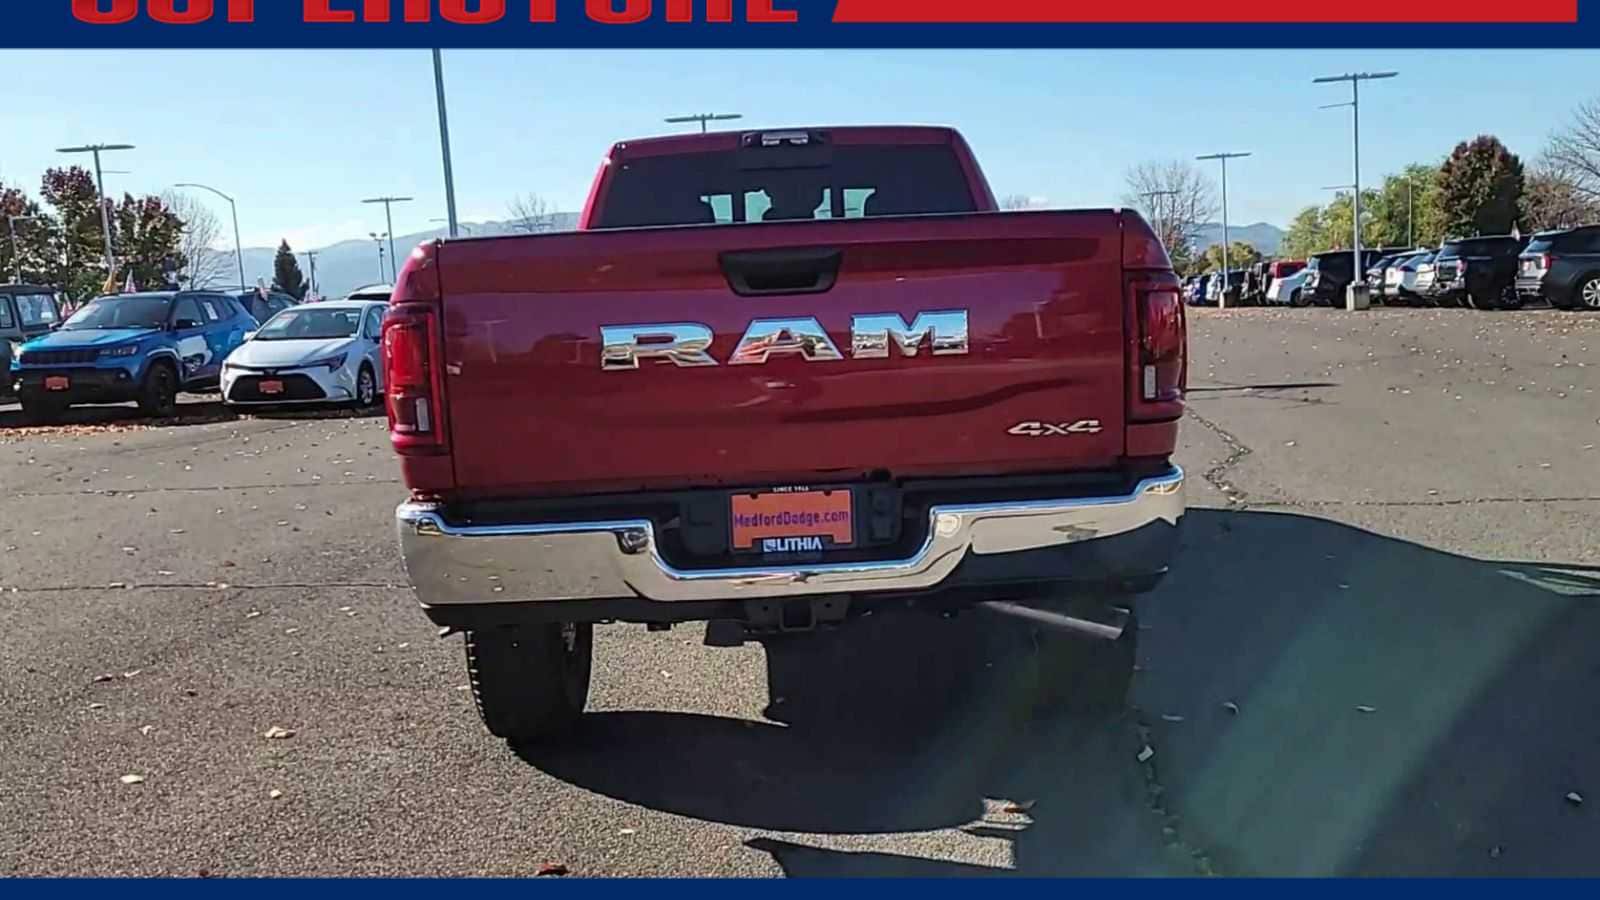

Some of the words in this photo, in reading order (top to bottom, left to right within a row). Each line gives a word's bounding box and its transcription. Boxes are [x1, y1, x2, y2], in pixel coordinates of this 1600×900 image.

[601, 309, 969, 371] RAM
[734, 511, 849, 528] MedfordDodge.com
[777, 537, 823, 551] LITHIA
